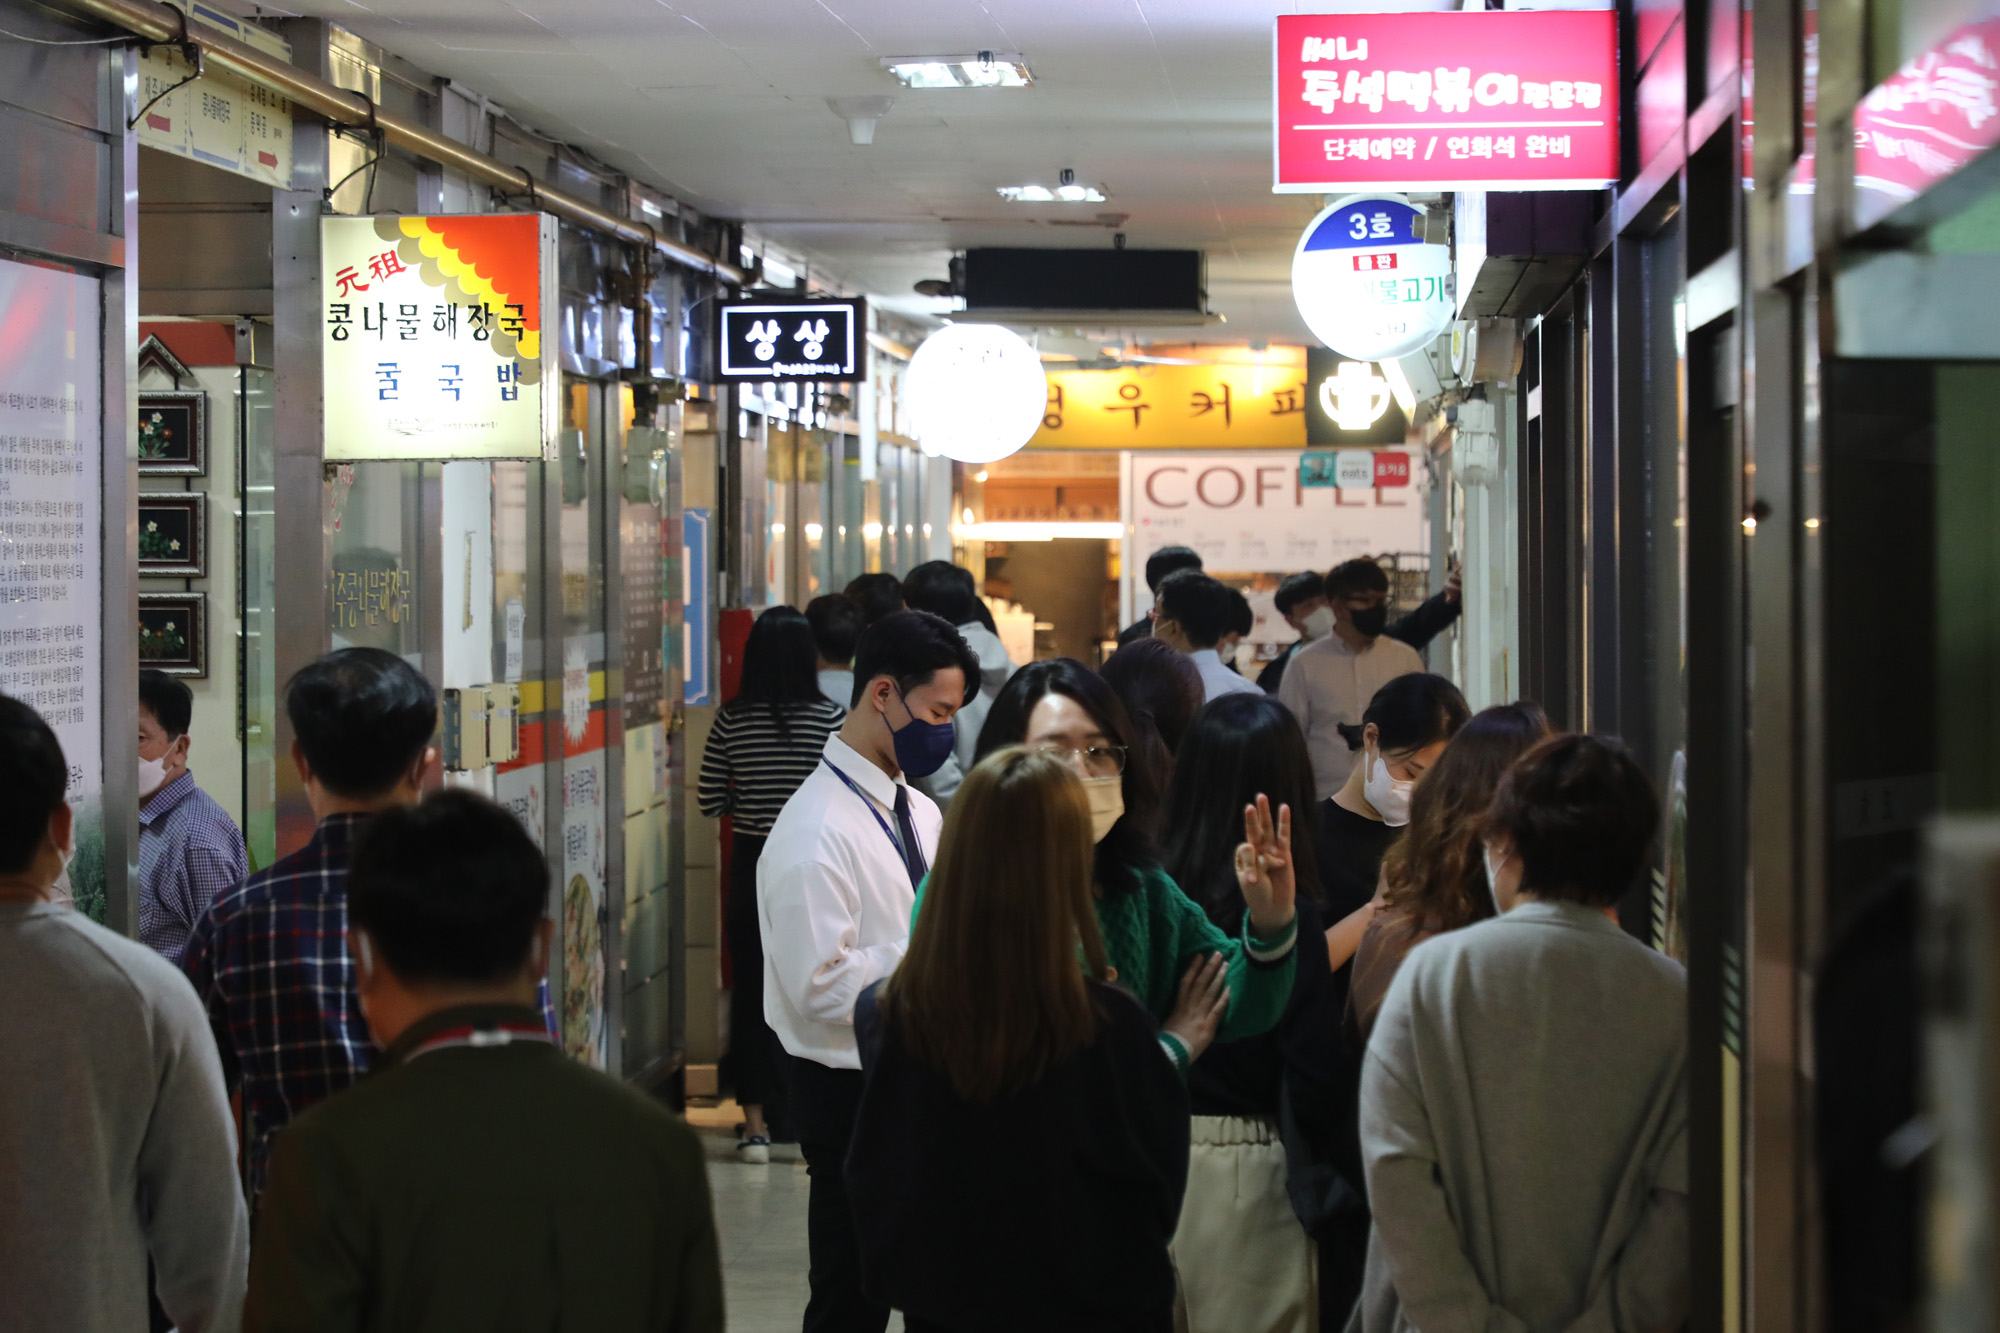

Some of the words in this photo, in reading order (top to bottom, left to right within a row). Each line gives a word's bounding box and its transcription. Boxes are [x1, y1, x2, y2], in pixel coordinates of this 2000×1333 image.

[1323, 137, 1416, 161] 단체예약
[1424, 136, 1438, 160] /
[1446, 136, 1516, 160] 연회석
[1525, 135, 1571, 158] 완비
[1349, 212, 1395, 240] 3호
[336, 250, 407, 298] 元祖
[328, 302, 527, 342] 콩나물해장국
